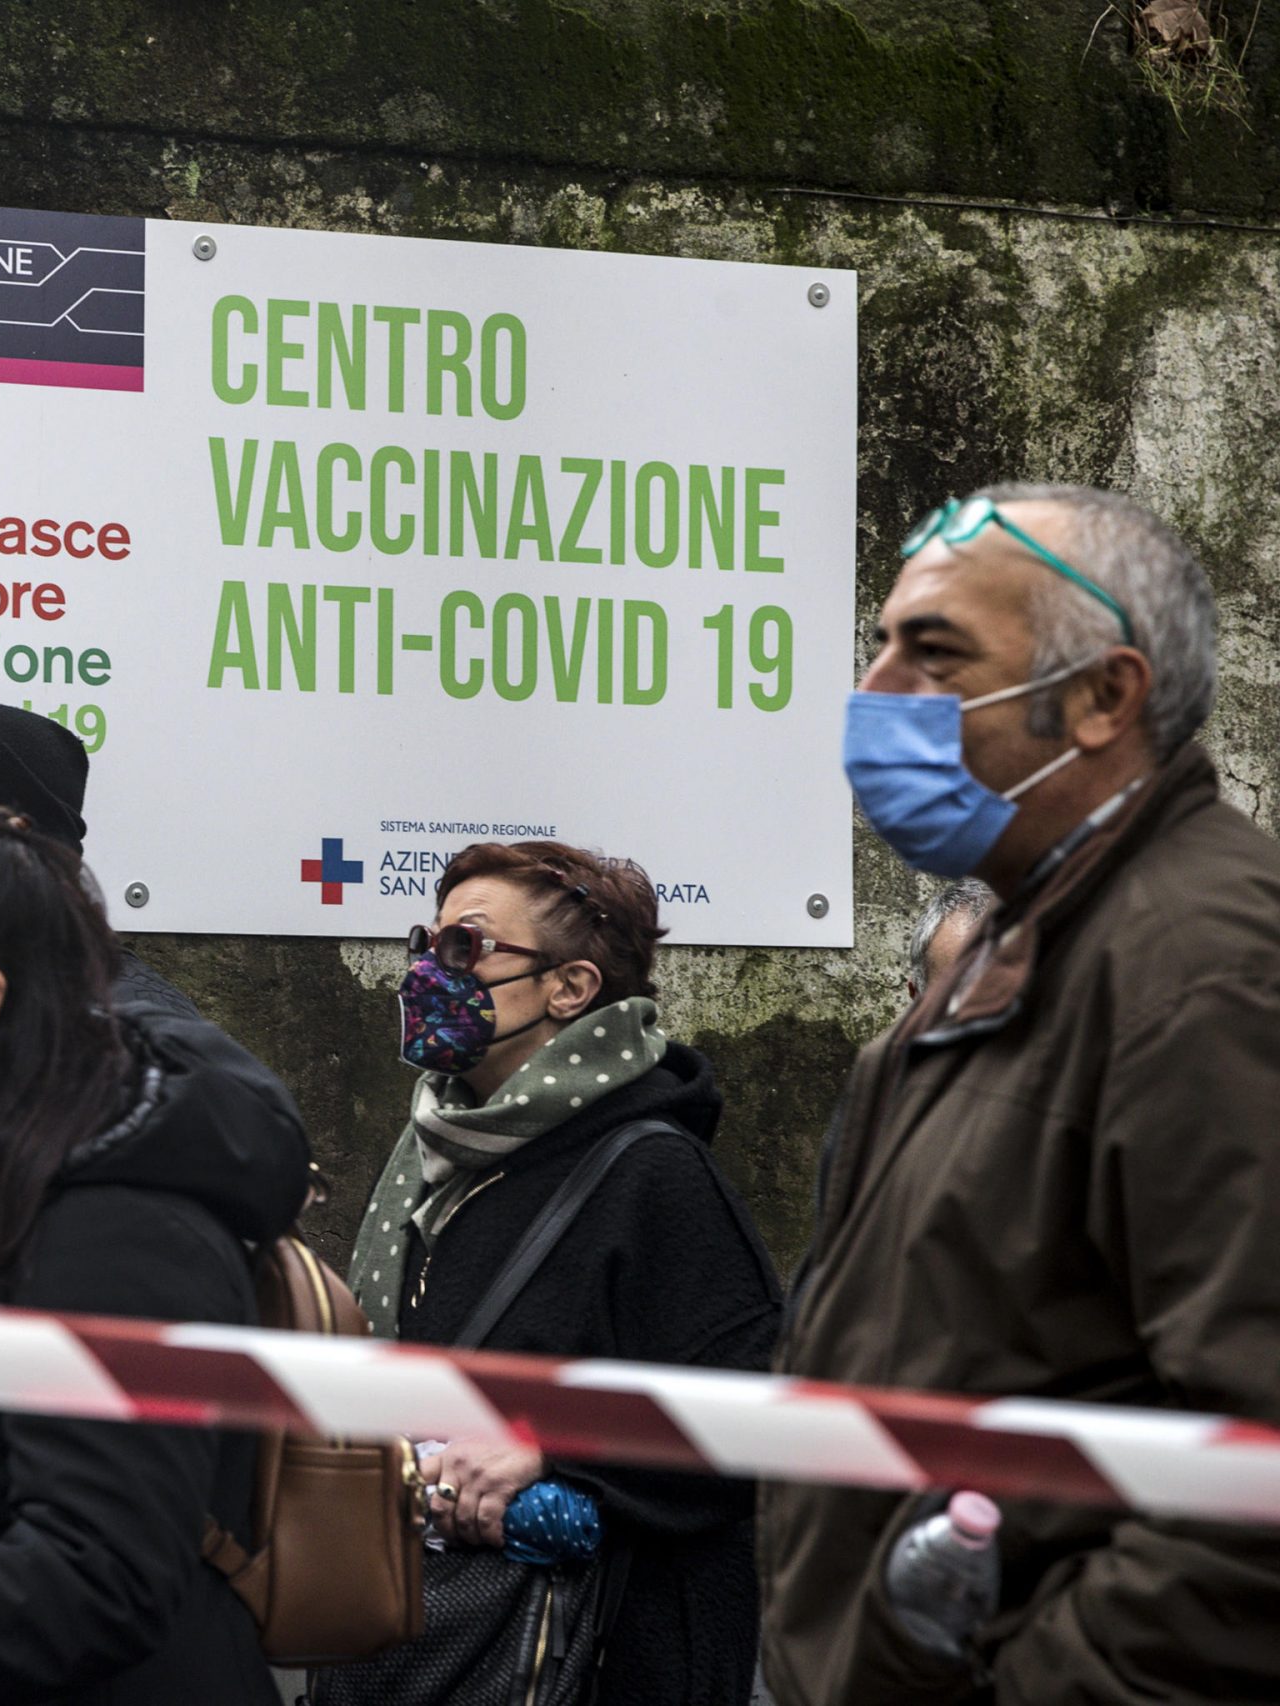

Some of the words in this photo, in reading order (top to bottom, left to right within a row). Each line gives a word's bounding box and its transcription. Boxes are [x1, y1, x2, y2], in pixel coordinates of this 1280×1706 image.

[211, 294, 527, 421] CENTRO
[208, 436, 786, 573] VACCINAZIONE
[207, 580, 668, 706] ANTI-COVID
[702, 604, 793, 713] 19
[379, 850, 458, 873] AZIEN
[380, 820, 426, 833] SISTEMA
[429, 822, 489, 835] SANITARIO
[492, 824, 556, 837] REGIONALE
[379, 875, 426, 897] SAN
